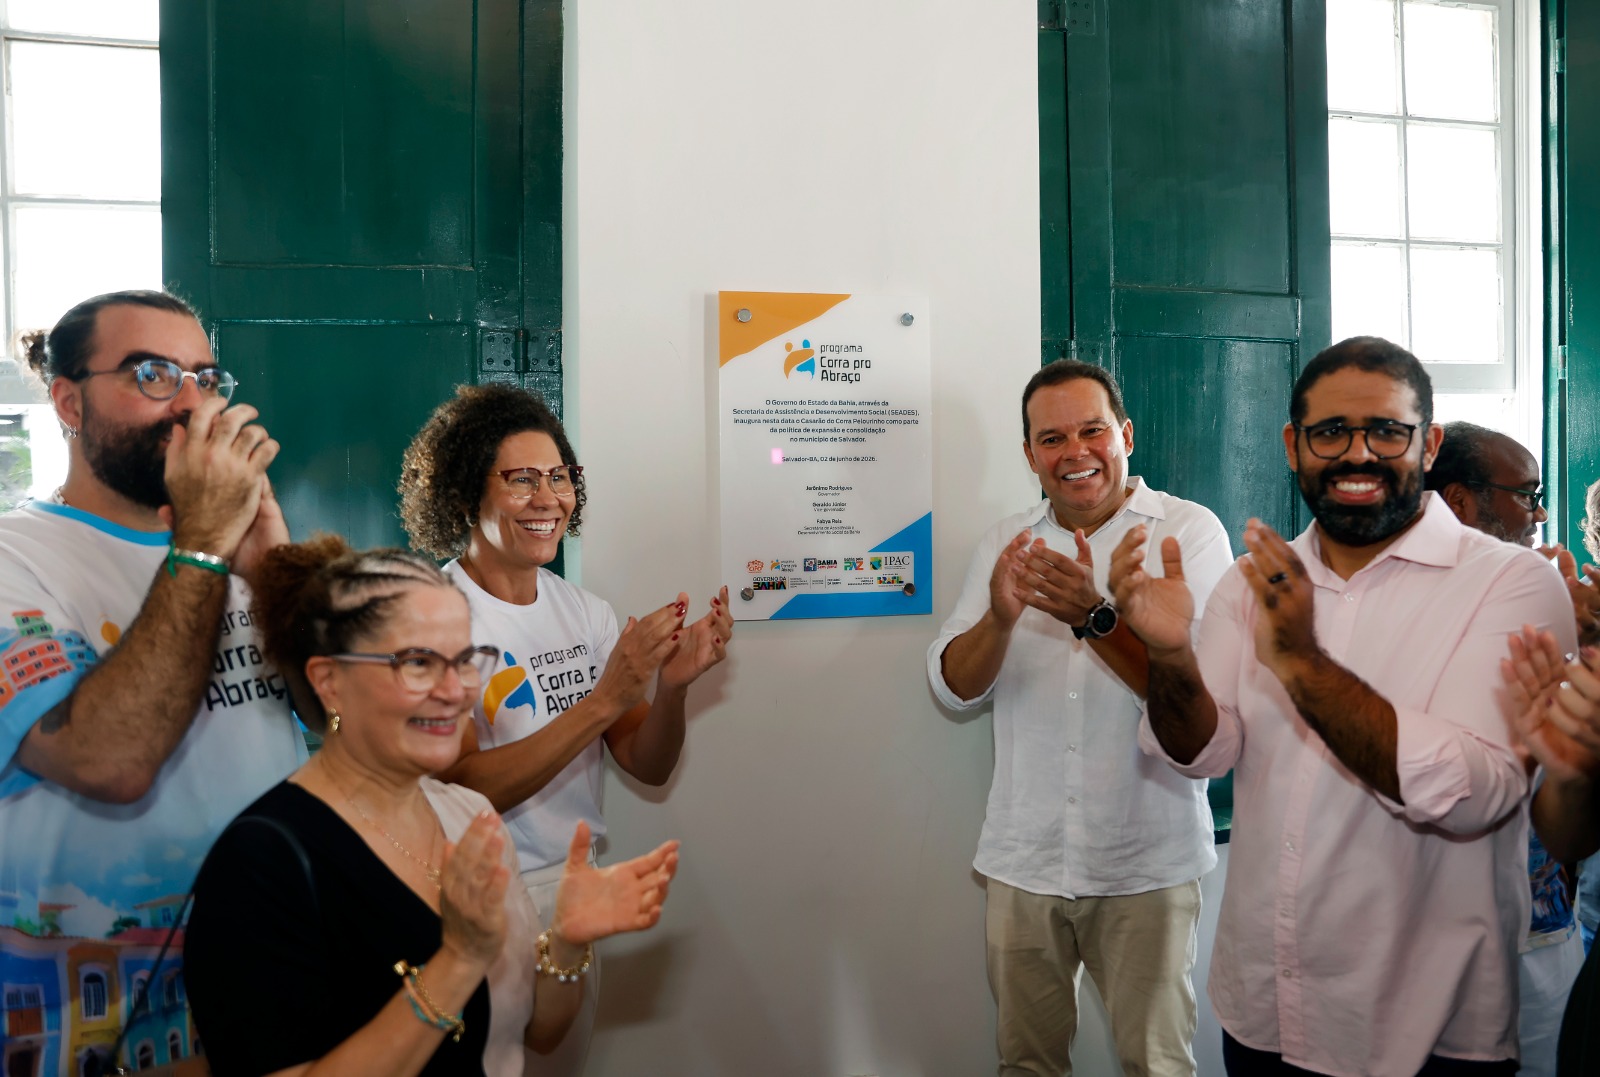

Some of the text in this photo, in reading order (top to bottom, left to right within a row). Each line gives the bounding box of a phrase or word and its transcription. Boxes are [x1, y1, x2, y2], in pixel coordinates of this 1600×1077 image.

[820, 344, 862, 354] programa
[820, 356, 871, 370] Corra pro
[820, 370, 861, 384] Abraço
[844, 561, 864, 570] PAZ
[884, 556, 910, 565] IPAC
[753, 581, 786, 590] BAHIA
[877, 576, 904, 584] BRASIL
[536, 669, 585, 693] Corra
[205, 673, 286, 712] Abraç
[545, 688, 593, 716] Abra
